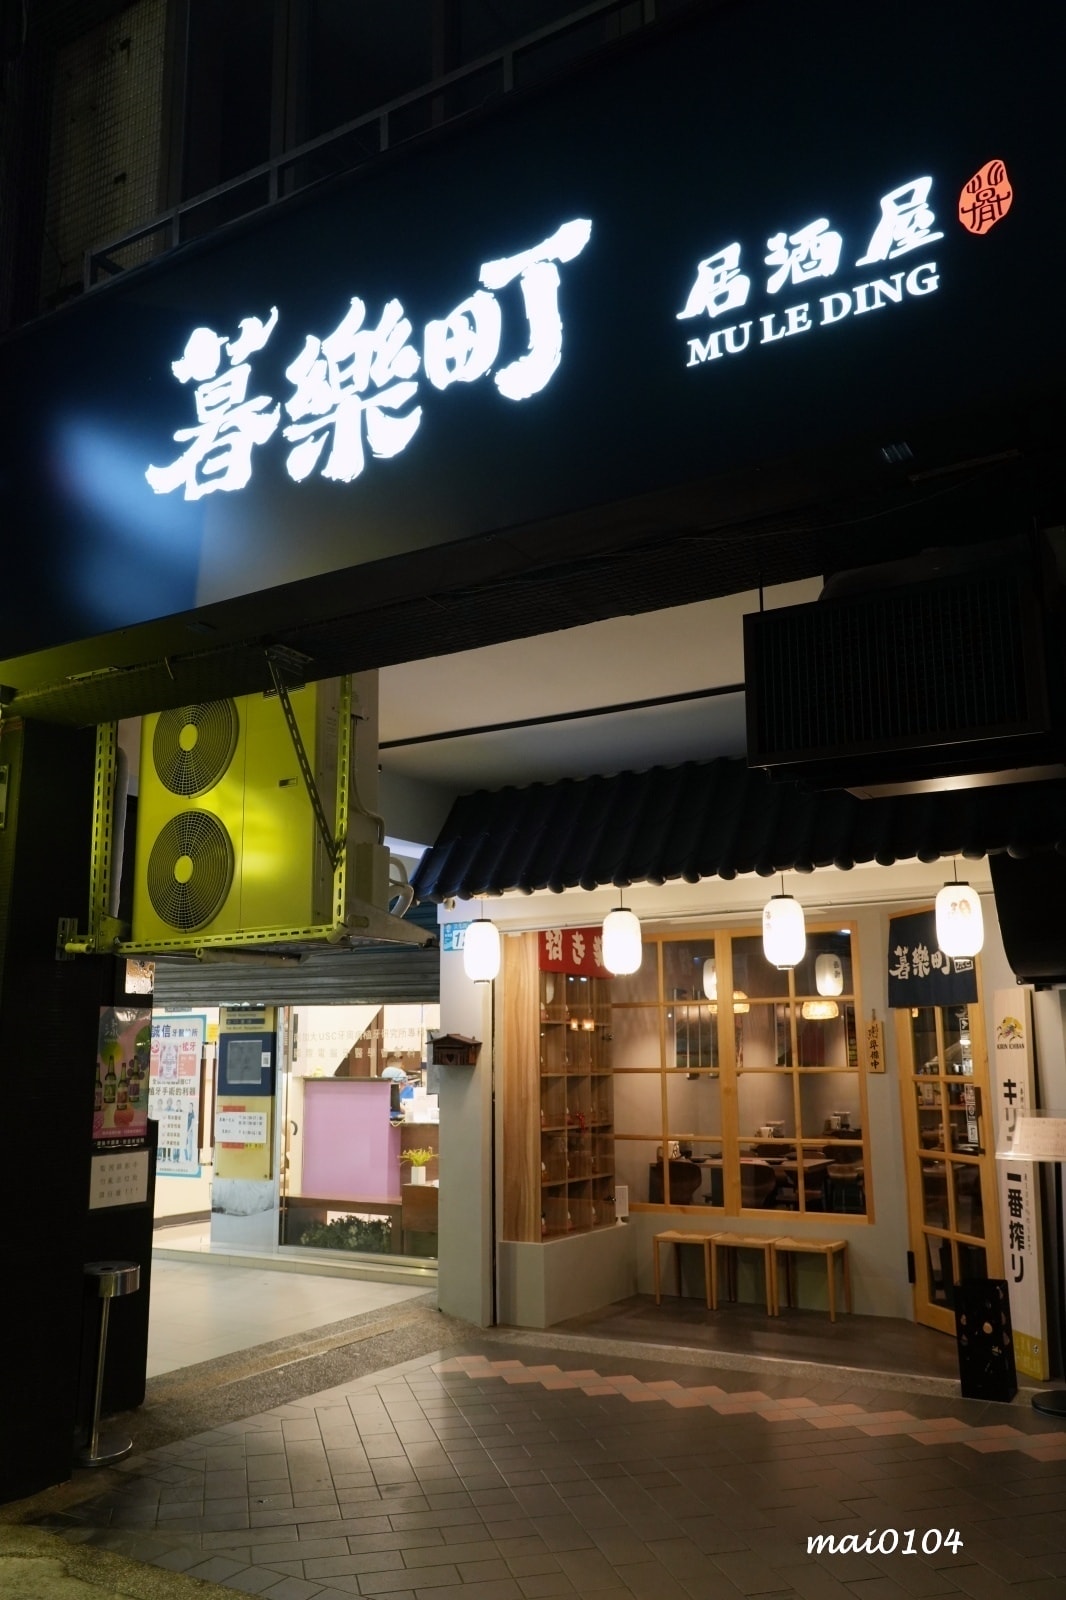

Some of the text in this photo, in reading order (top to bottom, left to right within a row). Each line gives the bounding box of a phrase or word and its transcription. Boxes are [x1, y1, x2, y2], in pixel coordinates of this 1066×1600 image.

[676, 176, 944, 320] 居酒屋
[686, 261, 941, 367] MU LE DING
[1006, 1172, 1025, 1283] 一番搾り
